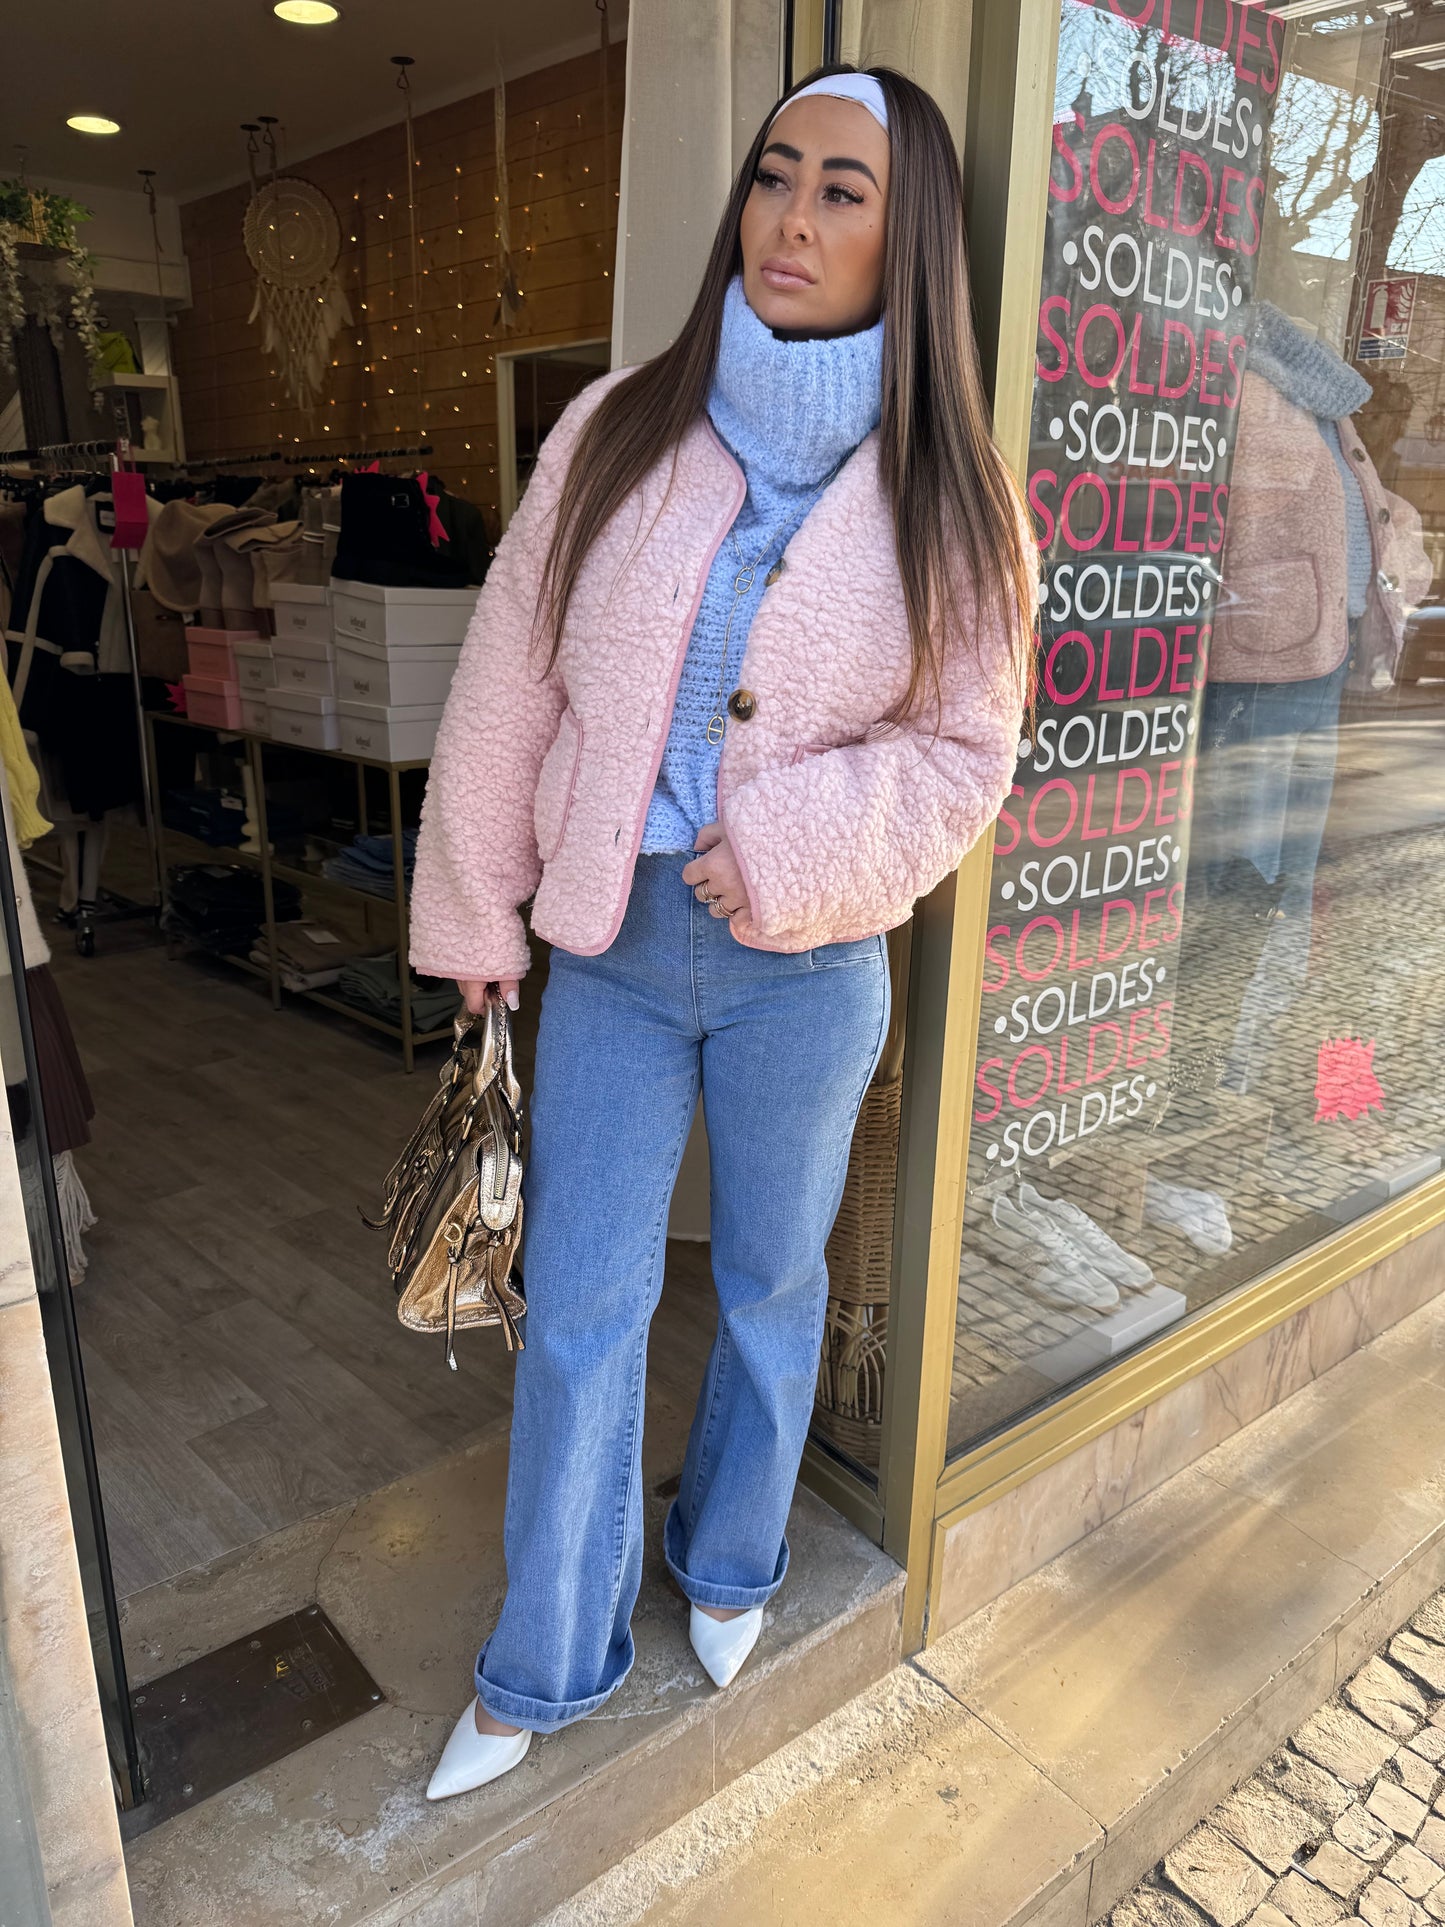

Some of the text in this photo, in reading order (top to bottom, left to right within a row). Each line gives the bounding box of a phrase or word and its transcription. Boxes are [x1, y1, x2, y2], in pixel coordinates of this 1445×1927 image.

[1050, 112, 1265, 256] SOLDES
[1079, 225, 1231, 320] SOLDES
[1036, 296, 1246, 409] SOLDES
[1065, 400, 1217, 472] SOLDES
[1028, 469, 1229, 553] SOLDES
[1051, 564, 1202, 622] SOLDES
[1026, 624, 1212, 705] OLDES
[1033, 704, 1187, 772] SOLDES
[994, 756, 1197, 855] SOLDES
[1018, 835, 1171, 911] SOLDES
[982, 882, 1182, 993] SOLDES
[1009, 957, 1156, 1043] SOLDES
[975, 1001, 1173, 1122] SOLDES
[1000, 1075, 1145, 1168] SOLDES
